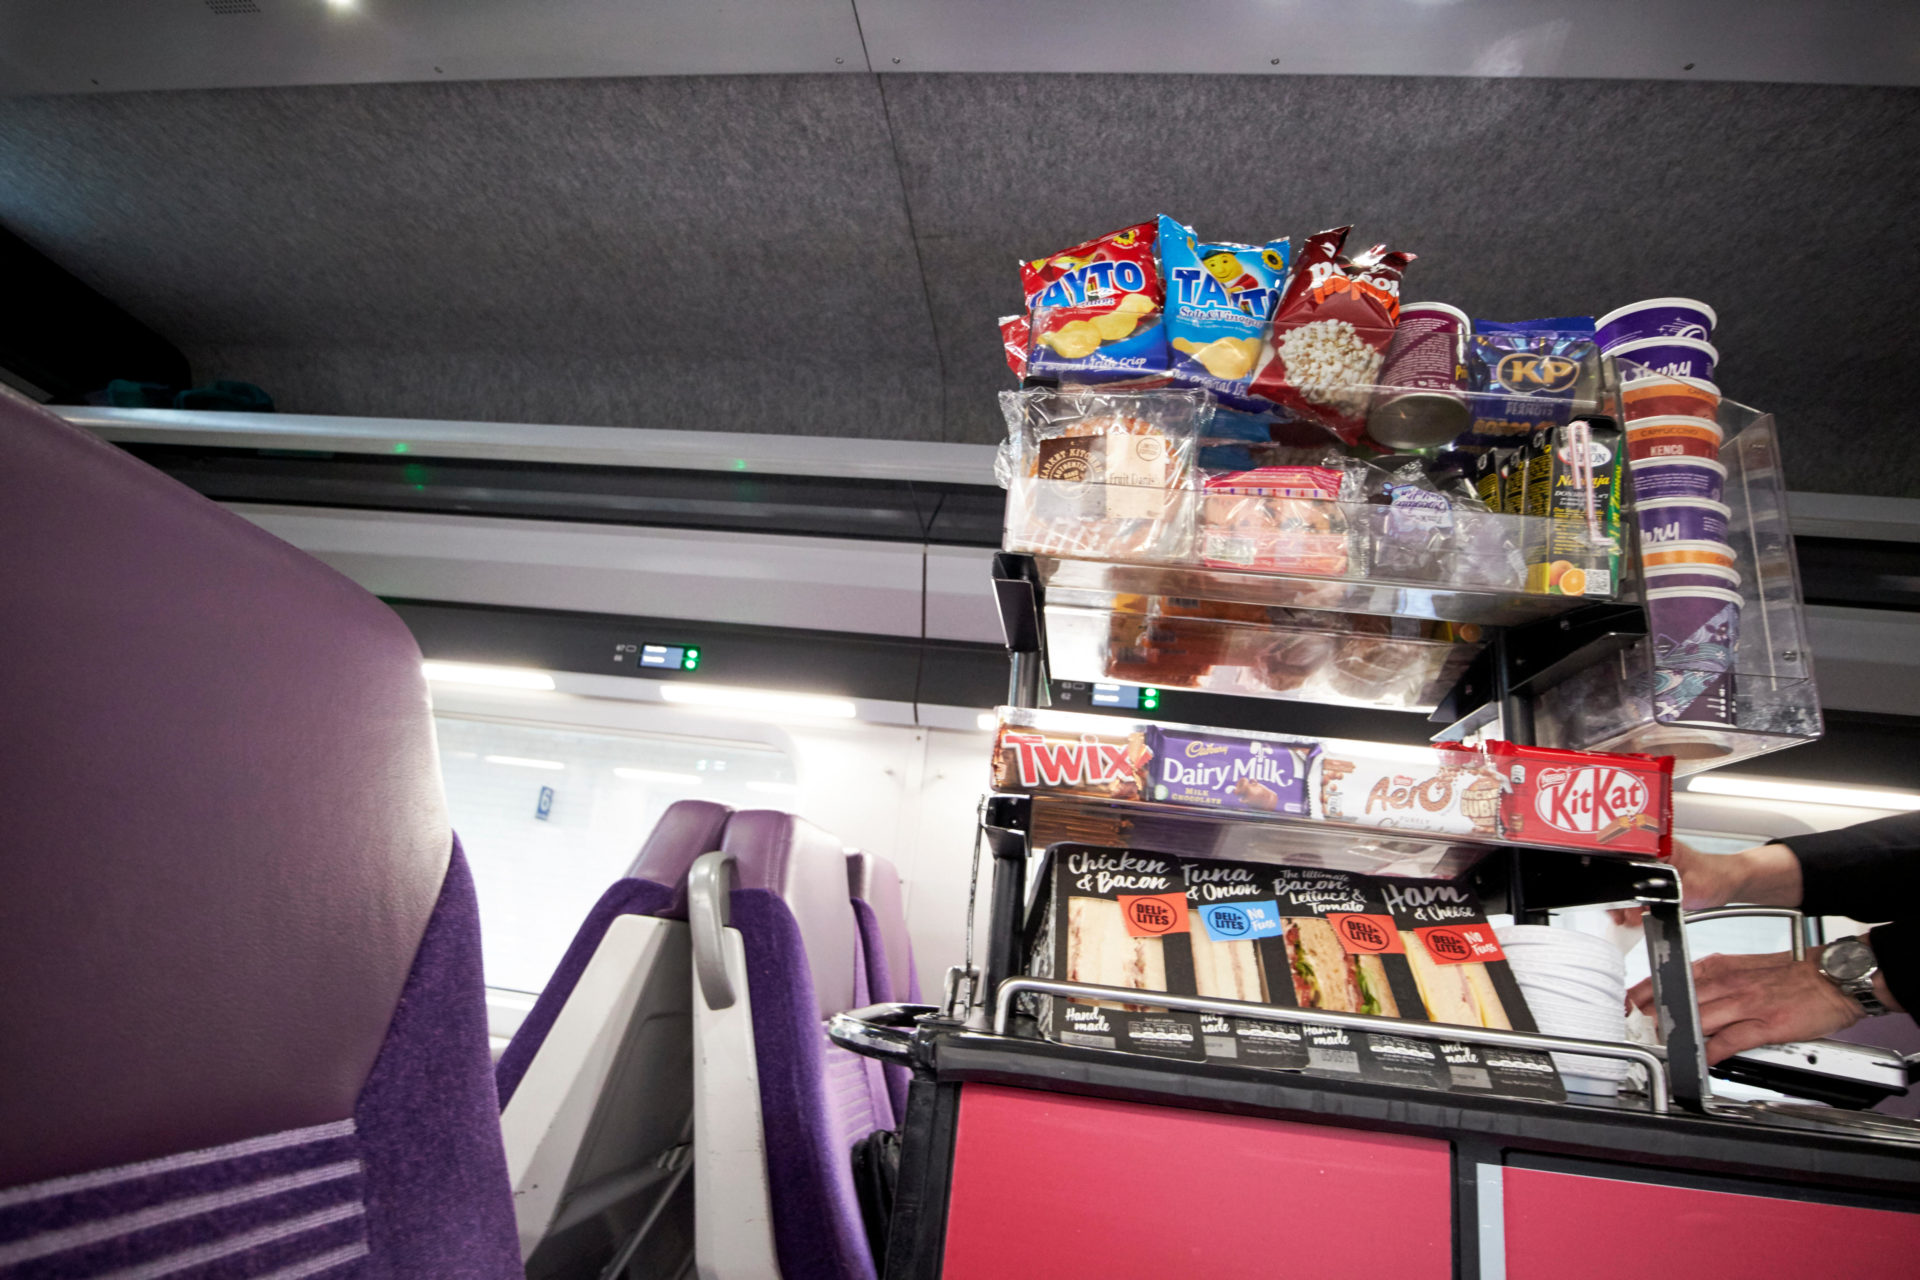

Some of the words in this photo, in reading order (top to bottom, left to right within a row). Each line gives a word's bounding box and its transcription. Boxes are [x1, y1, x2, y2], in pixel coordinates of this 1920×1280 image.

[1511, 360, 1573, 384] KP
[1650, 444, 1684, 456] KENCO
[1185, 740, 1229, 758] Cadbury
[1162, 757, 1231, 790] Dairy
[1232, 756, 1293, 788] Milk
[1551, 768, 1641, 831] KitKat
[1068, 851, 1171, 874] Chicken
[1076, 874, 1094, 892] &
[1096, 871, 1172, 893] Bacon
[1179, 863, 1255, 886] Tuna
[1279, 869, 1299, 879] The
[1185, 885, 1200, 901] &
[1202, 881, 1262, 901] Onion
[1289, 890, 1350, 905] Lettuce
[1352, 888, 1367, 904] &
[1380, 882, 1470, 916] Ham
[1247, 908, 1265, 920] No
[1306, 901, 1364, 915] Tomato
[1414, 907, 1428, 921] &
[1427, 903, 1476, 921] Cheese
[1137, 914, 1170, 926] LITES
[1215, 919, 1245, 931] LITES
[1251, 919, 1277, 932] Fuss
[1349, 930, 1384, 946] LITES
[1464, 931, 1483, 944] No
[1435, 943, 1467, 955] LITES
[1472, 943, 1498, 956] Fuss
[1065, 1006, 1102, 1022] Hand
[1074, 1014, 1111, 1033] made
[1313, 1031, 1351, 1046] made
